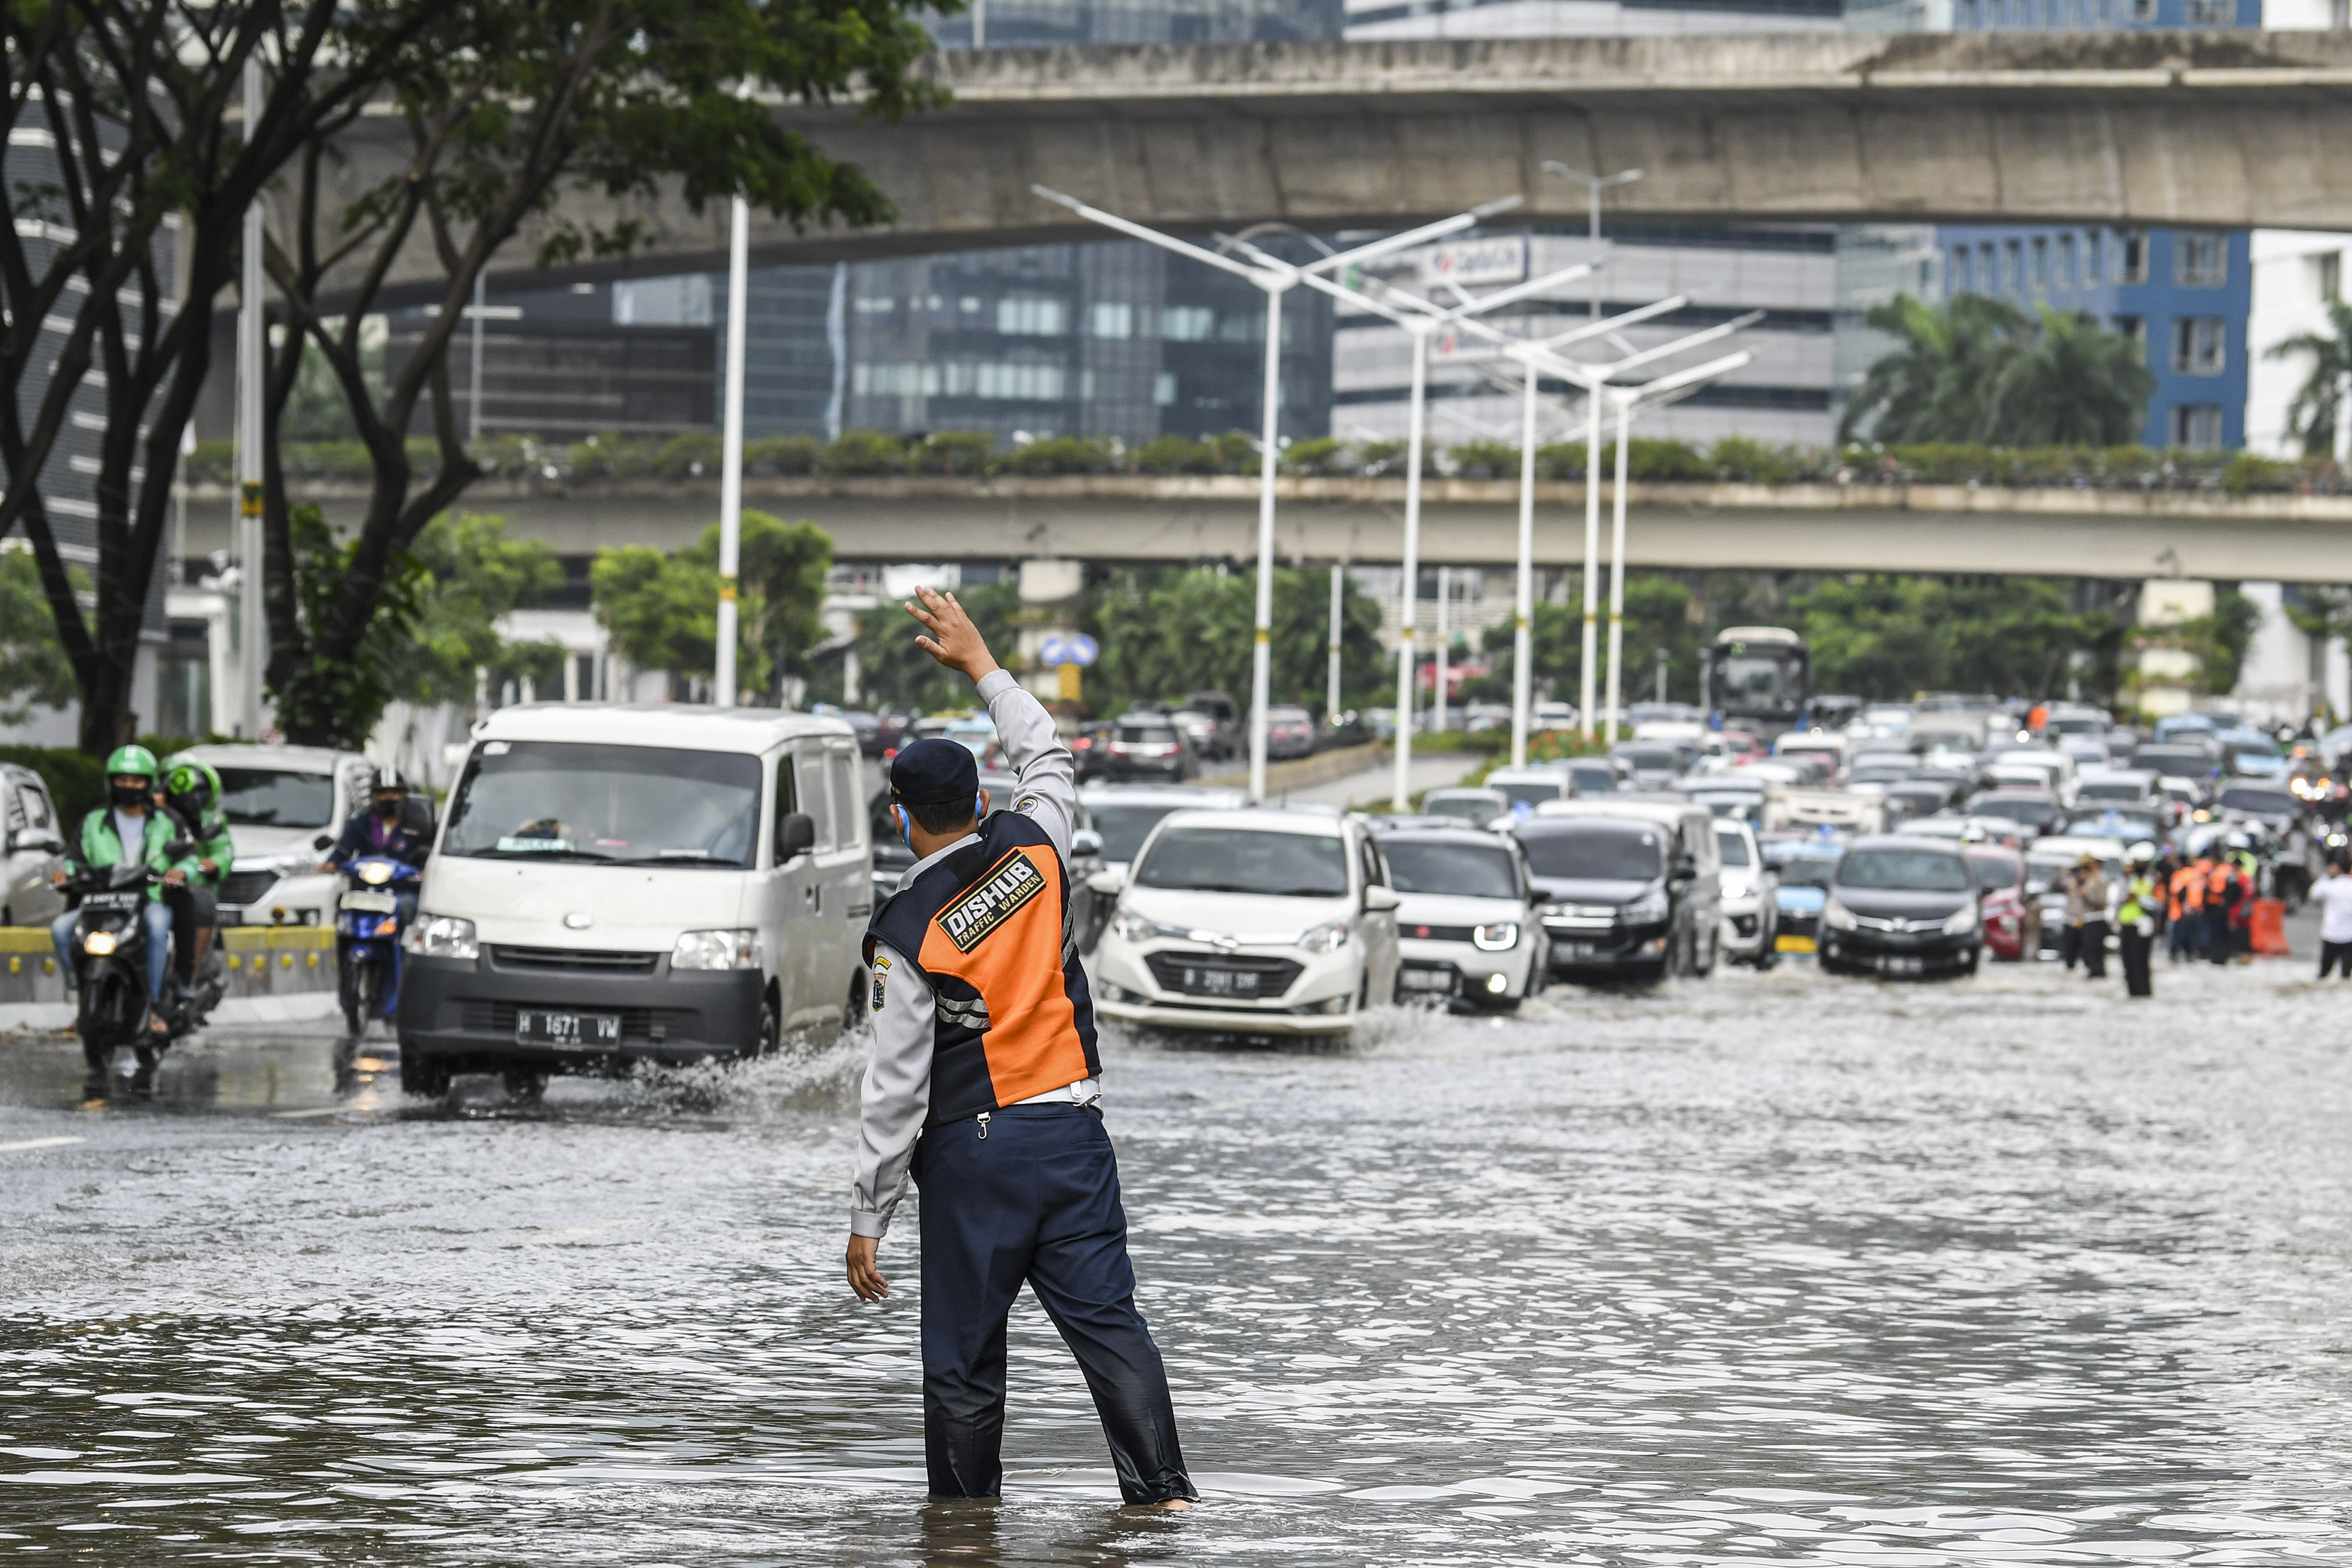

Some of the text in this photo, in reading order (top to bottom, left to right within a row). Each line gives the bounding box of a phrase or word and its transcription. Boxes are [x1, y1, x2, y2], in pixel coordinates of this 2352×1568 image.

[947, 861, 1033, 937] DISHUB
[957, 874, 1041, 945] TRAFFIC WARDEN
[546, 1014, 580, 1035] 1671
